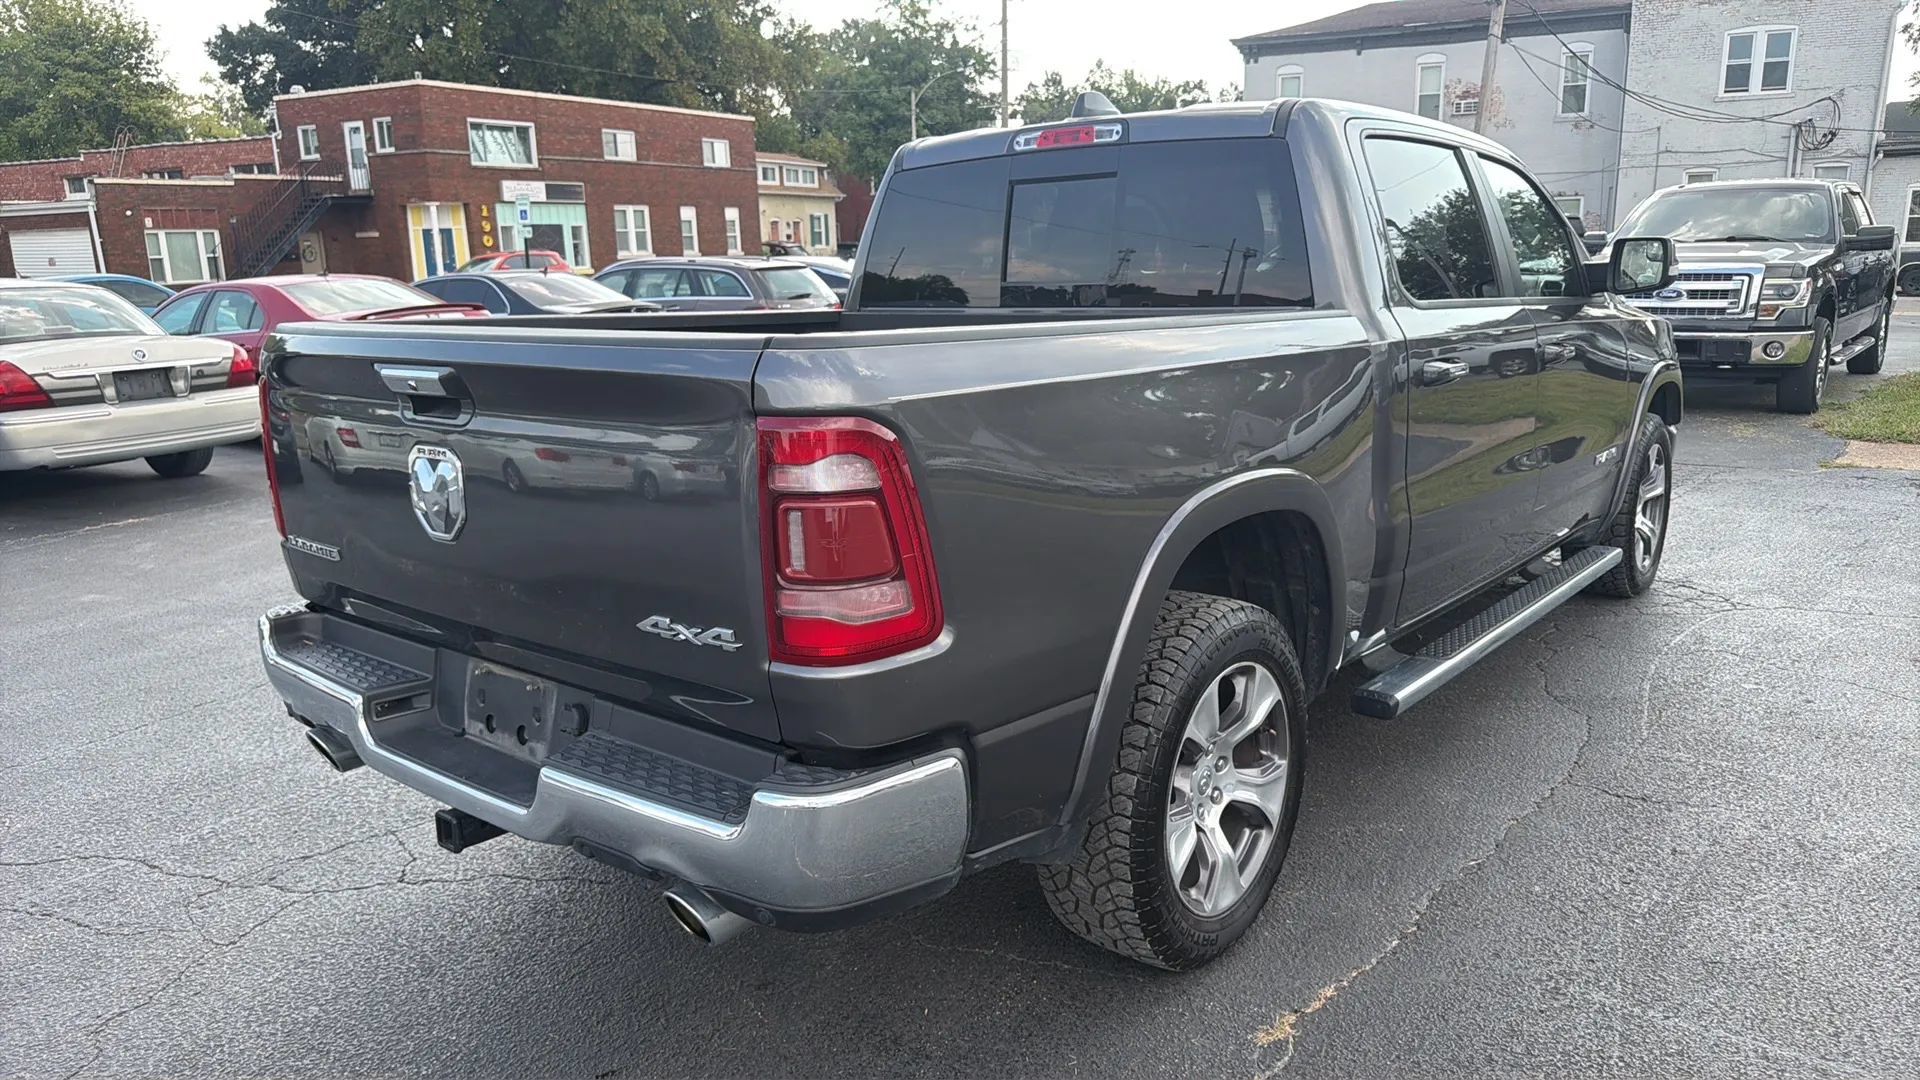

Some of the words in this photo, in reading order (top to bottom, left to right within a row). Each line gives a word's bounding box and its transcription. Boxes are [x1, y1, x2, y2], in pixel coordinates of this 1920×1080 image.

[481, 204, 494, 248] 190
[416, 447, 448, 458] RAM
[287, 536, 338, 560] LARAMIE
